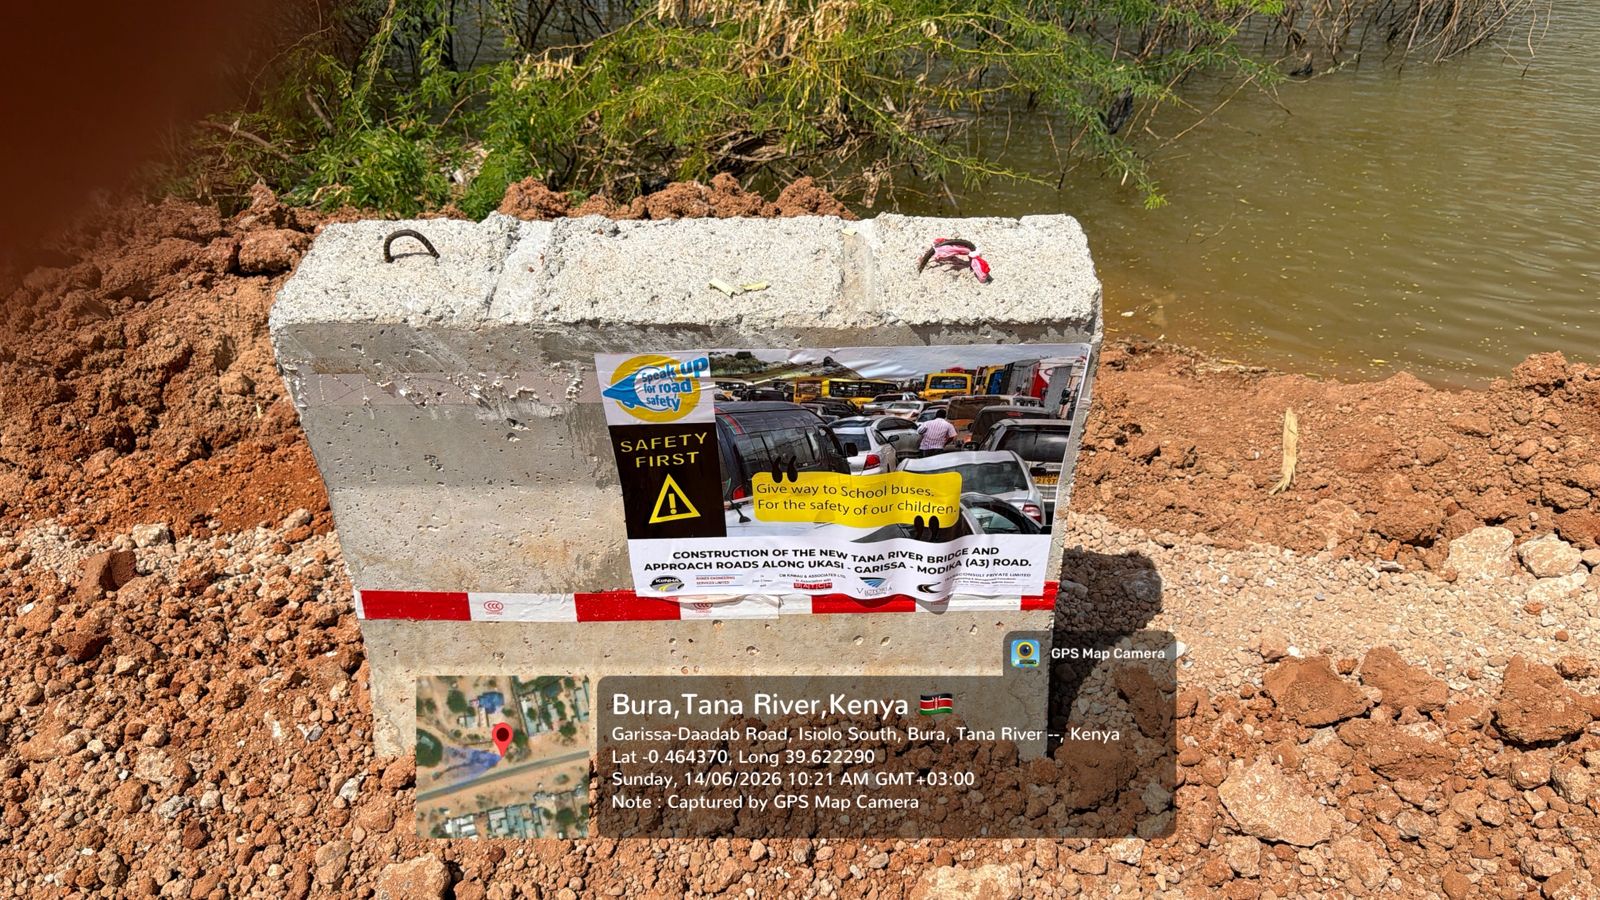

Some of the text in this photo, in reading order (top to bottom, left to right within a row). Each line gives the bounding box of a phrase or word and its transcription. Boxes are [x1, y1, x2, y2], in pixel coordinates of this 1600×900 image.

[642, 357, 709, 384] Speak up
[643, 378, 692, 394] for road
[646, 395, 681, 412] safety
[620, 432, 708, 453] SAFETY
[636, 451, 700, 468] FIRST
[756, 481, 935, 499] Give way to School buses.
[758, 499, 957, 516] For the safety of our children.
[672, 547, 1000, 564] CONSTRUCTION OF THE NEW TANA RIVER BRIDGE AND
[643, 562, 713, 572] APPROACH
[716, 561, 760, 569] ROADS
[762, 560, 805, 569] ALONG
[807, 560, 845, 570] UKASI
[854, 562, 906, 574] GARISSA
[916, 561, 963, 575] MODIKA
[965, 558, 990, 569] (A3)
[992, 558, 1032, 567] ROAD.
